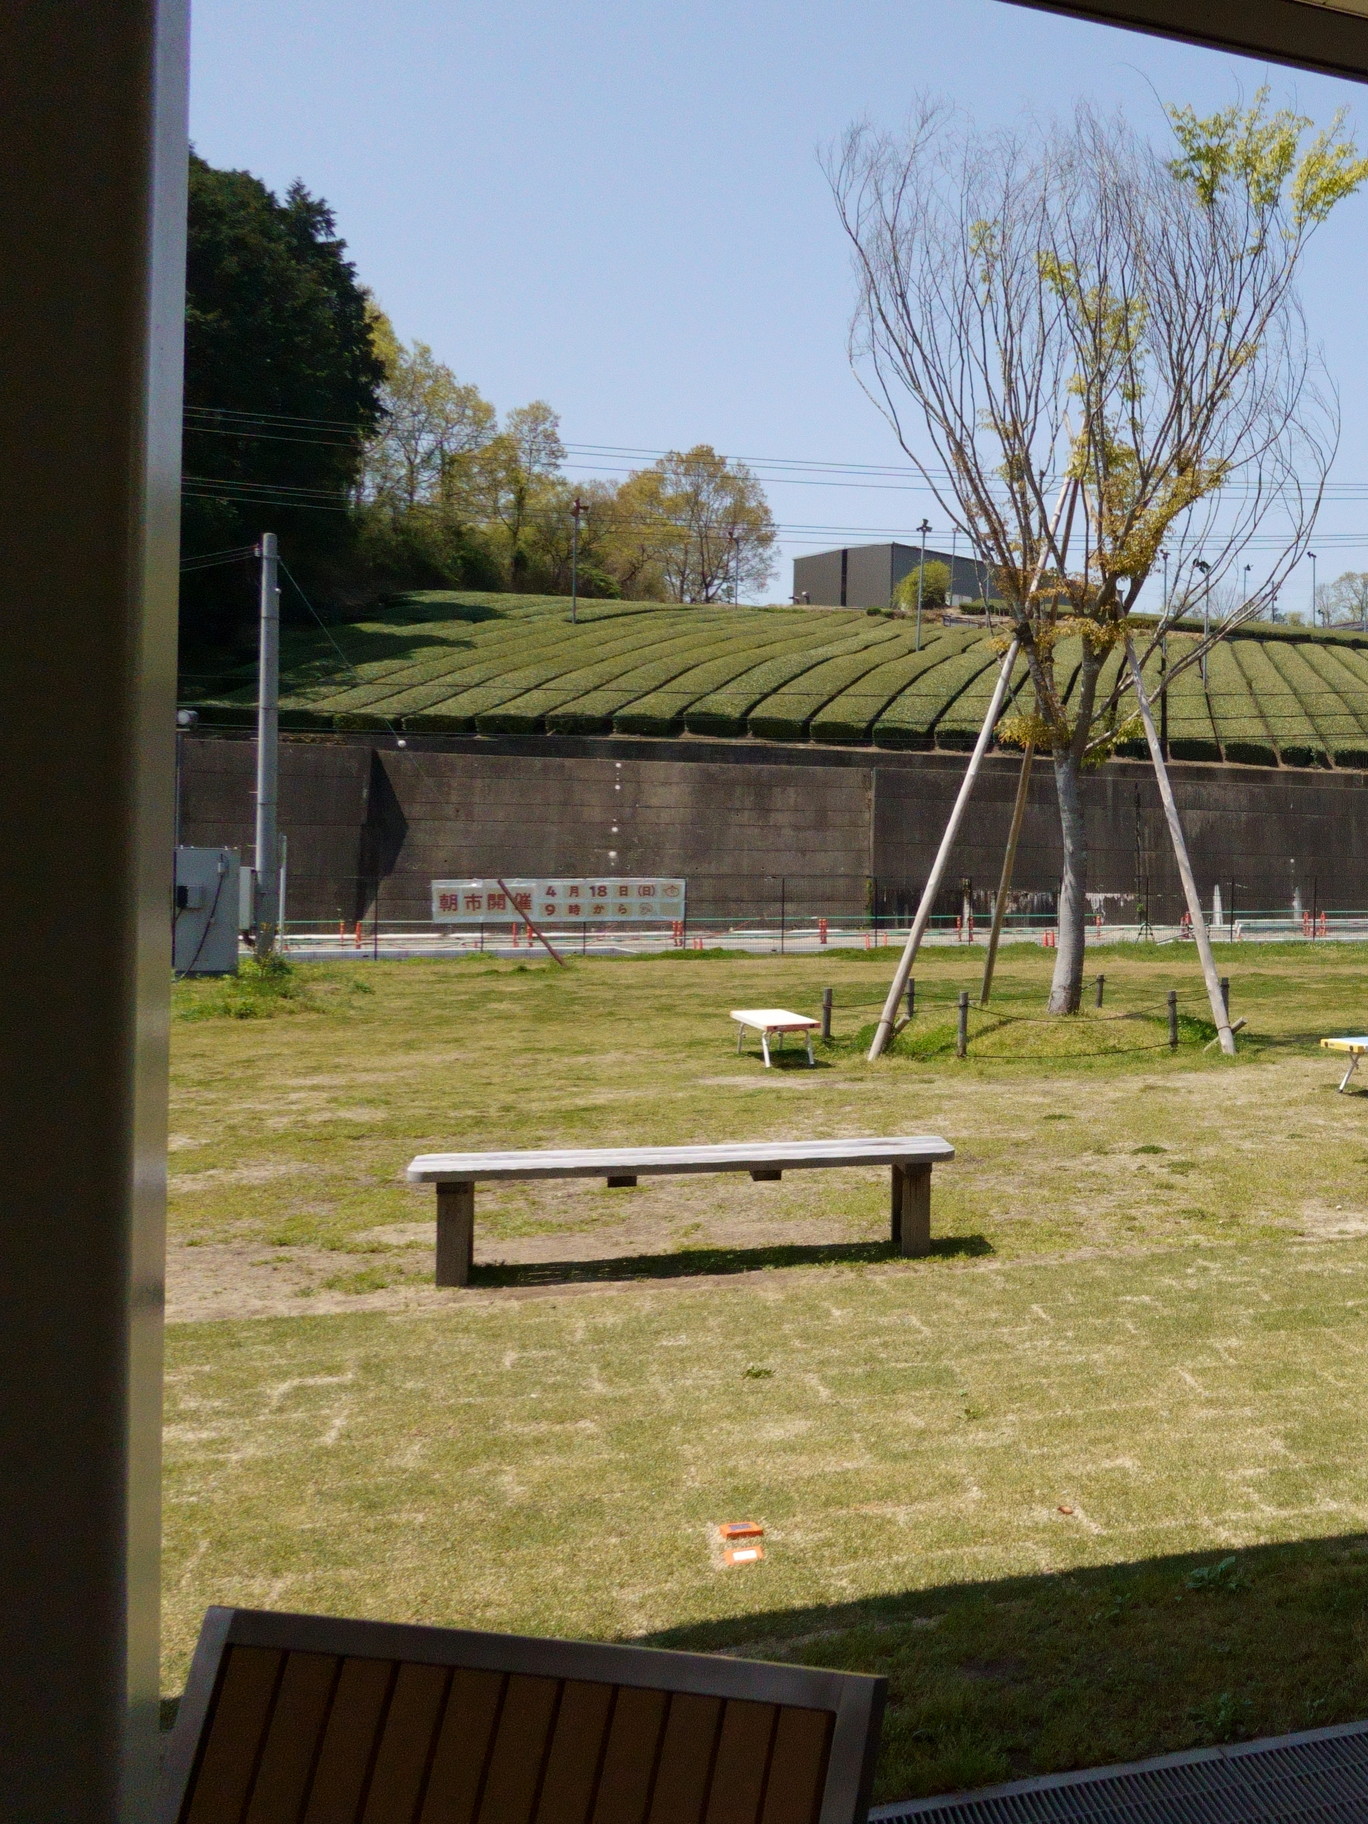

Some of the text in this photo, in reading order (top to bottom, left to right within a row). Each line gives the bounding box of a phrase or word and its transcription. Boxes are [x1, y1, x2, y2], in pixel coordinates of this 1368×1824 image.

[439, 893, 533, 912] 朝市開催
[544, 903, 628, 916] 9時から
